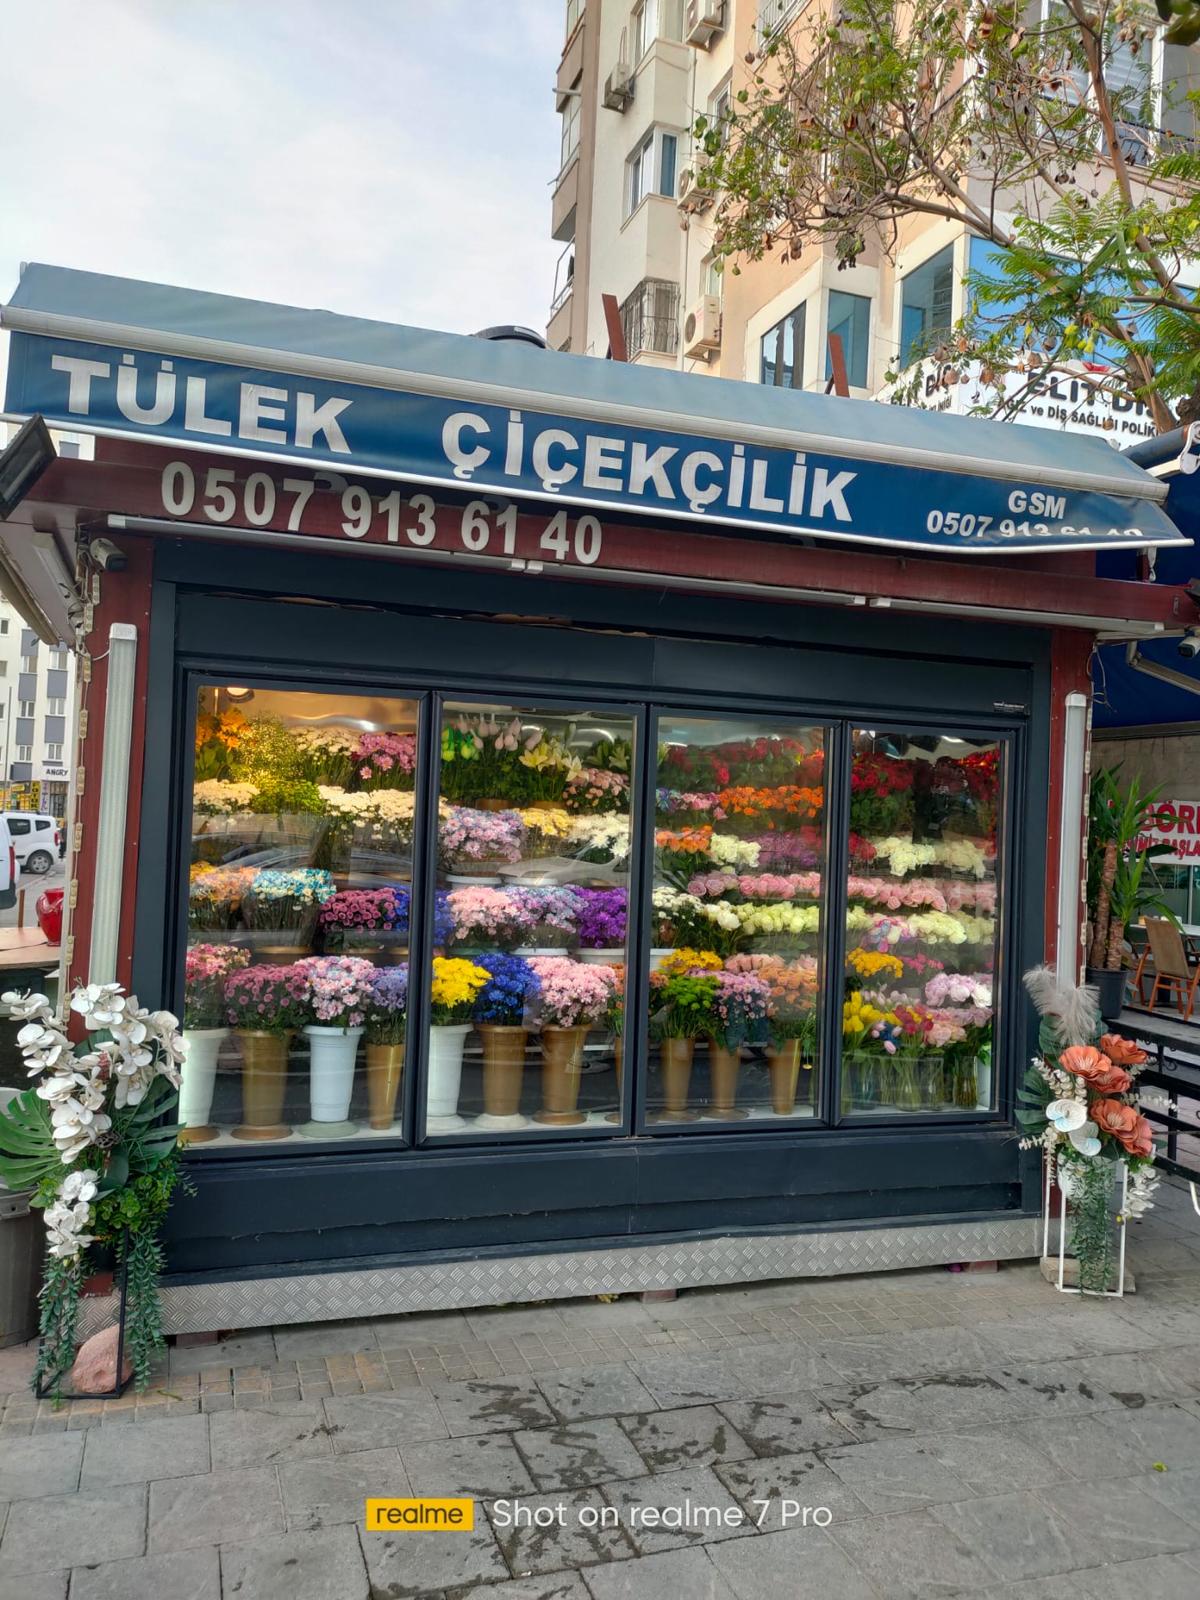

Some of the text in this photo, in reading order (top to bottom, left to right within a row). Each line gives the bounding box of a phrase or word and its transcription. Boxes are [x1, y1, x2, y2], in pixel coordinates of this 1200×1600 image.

[1031, 405, 1044, 416] ve
[1122, 421, 1158, 437] POLİK
[51, 354, 858, 522] TÜLEK ÇİÇEKÇİLİK
[161, 461, 602, 565] 0507 913 61 40
[1008, 490, 1066, 520] GSM
[926, 510, 993, 538] 0507
